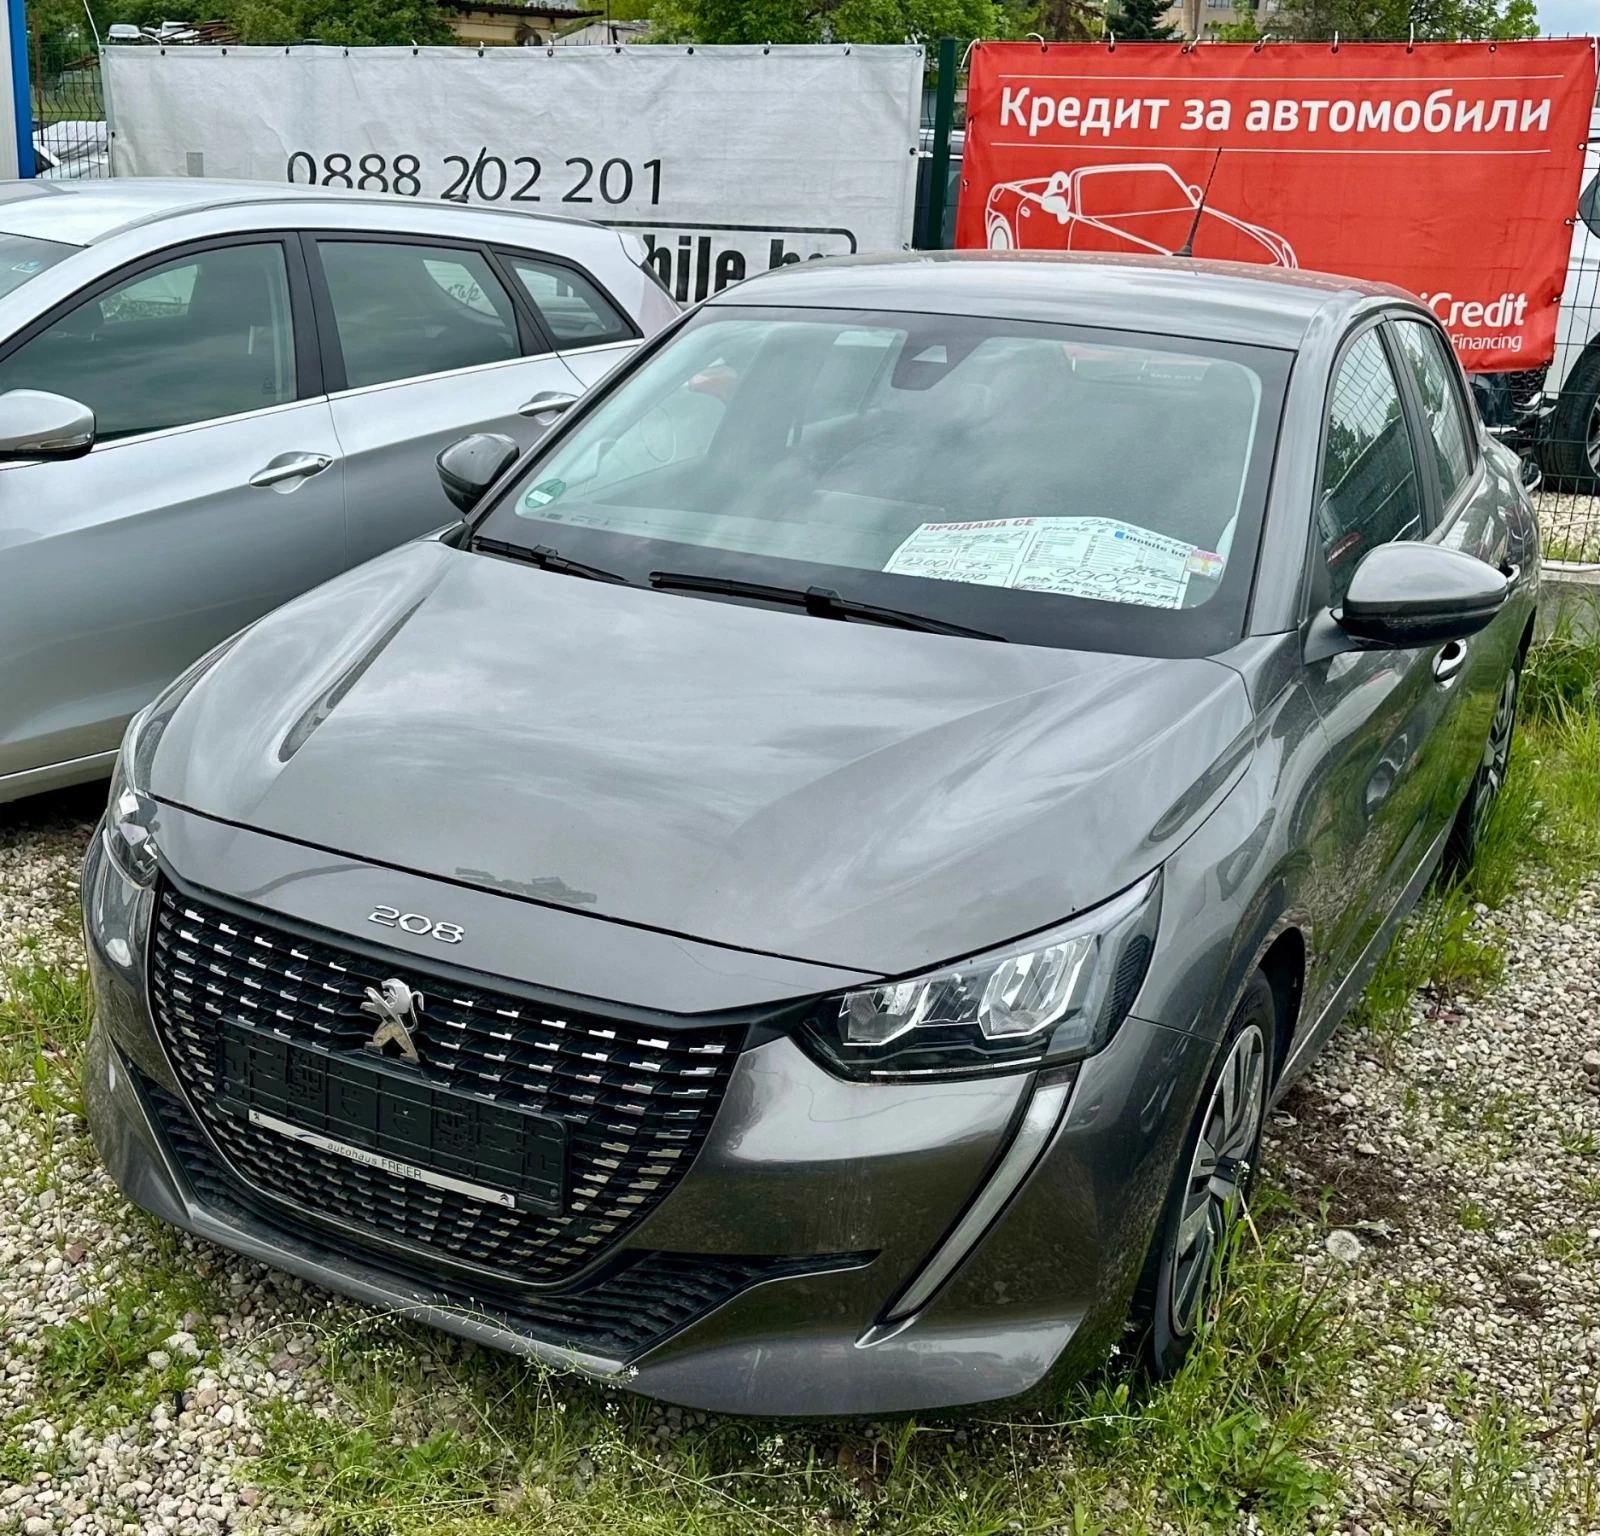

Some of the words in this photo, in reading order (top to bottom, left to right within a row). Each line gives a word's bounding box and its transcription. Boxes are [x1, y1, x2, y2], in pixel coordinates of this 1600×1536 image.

[1000, 86, 1170, 137] Кредит
[1180, 98, 1232, 131] за
[1244, 88, 1551, 133] автомобили
[287, 151, 421, 197] 0888
[561, 157, 662, 205] 201
[923, 519, 1007, 531] ПРОДАВА
[1013, 518, 1037, 527] СЕ
[367, 904, 465, 944] 208
[326, 1141, 378, 1166] autohaus
[381, 1158, 423, 1180] FREIER
